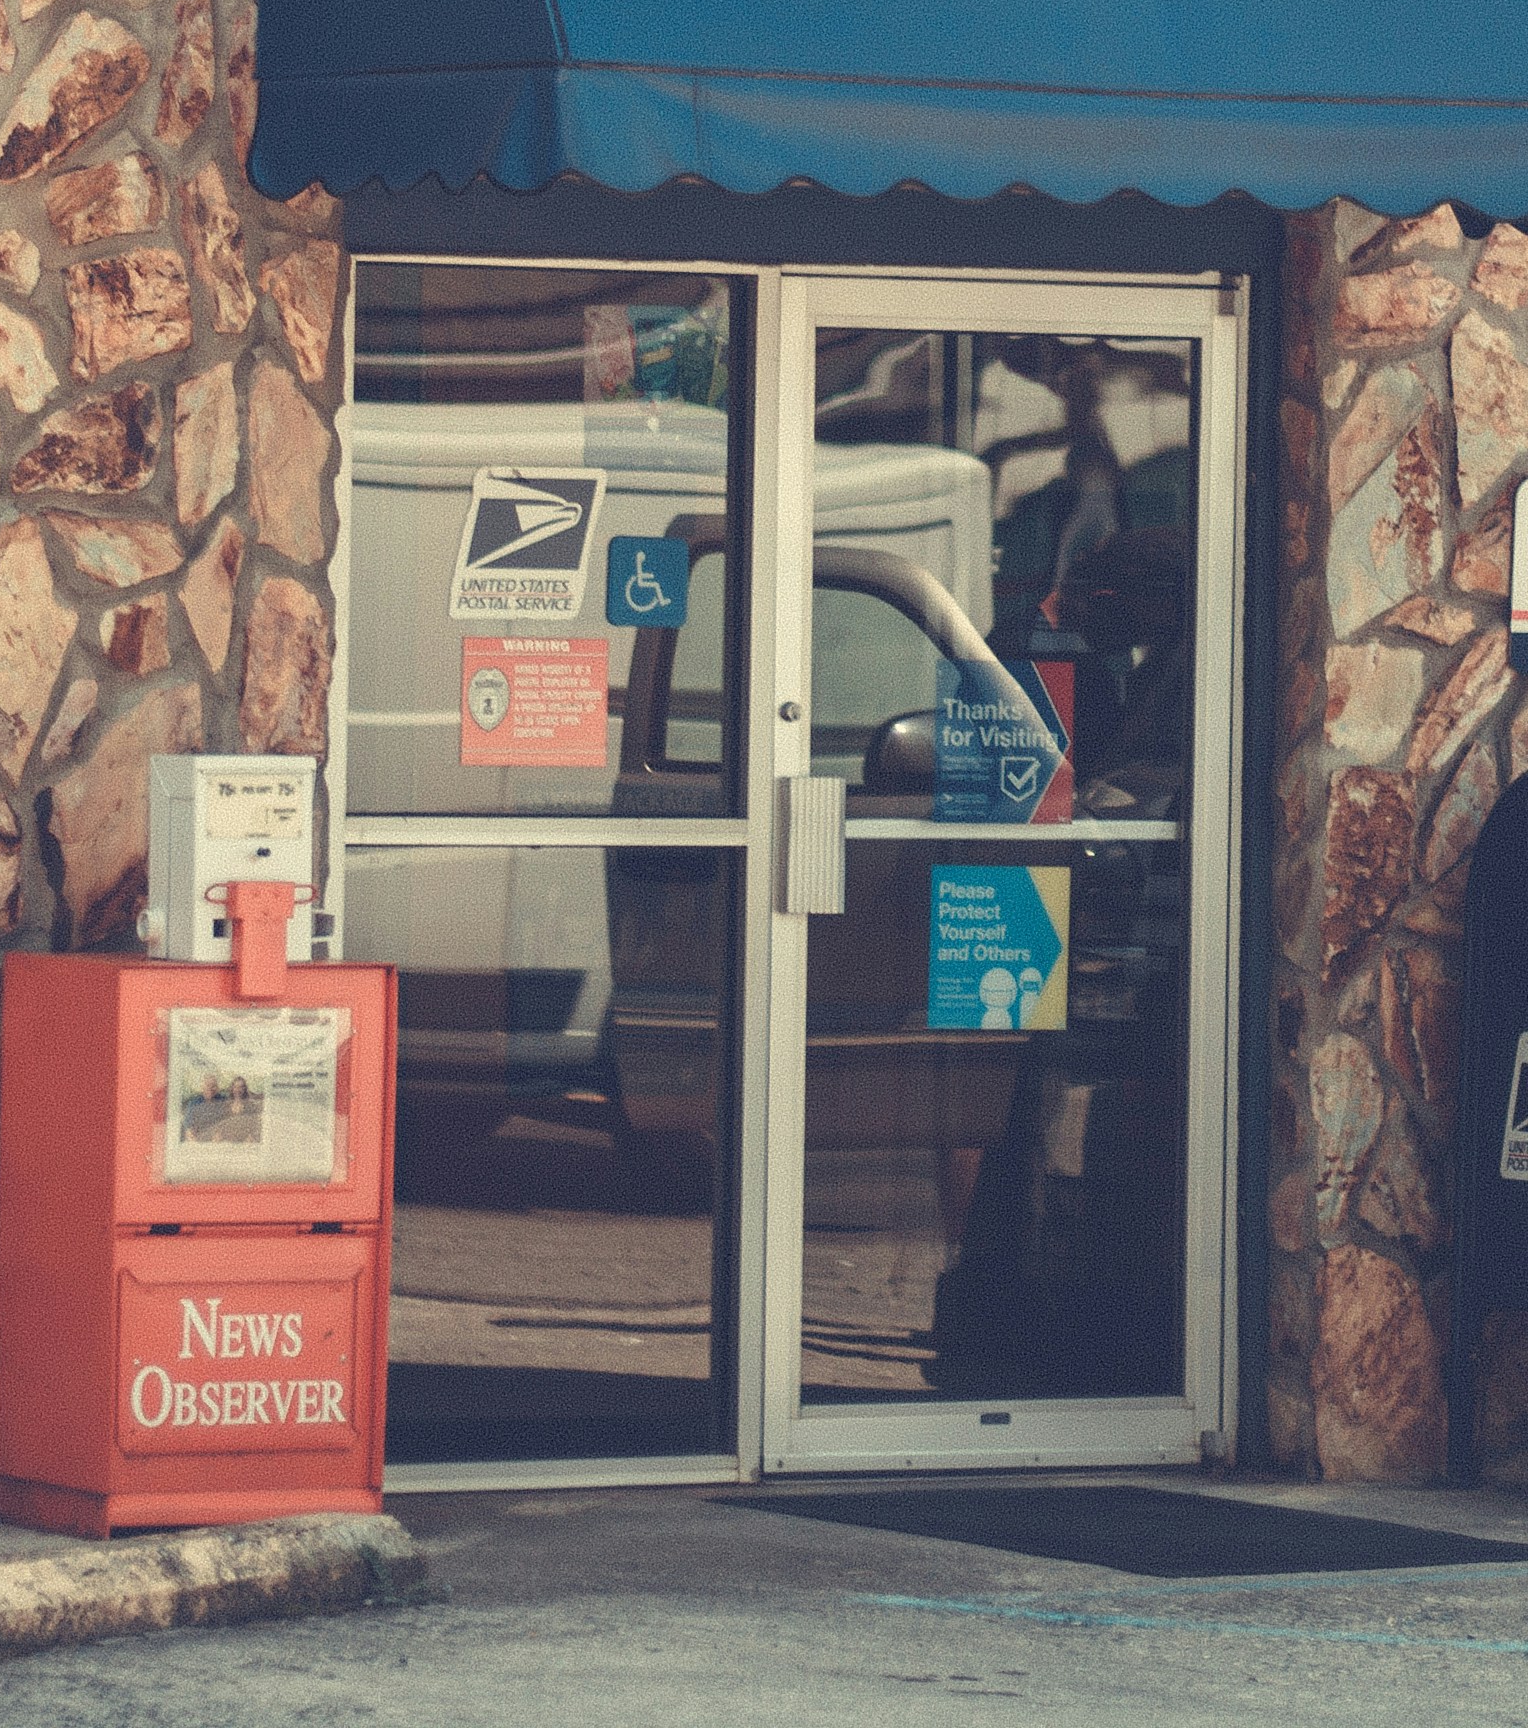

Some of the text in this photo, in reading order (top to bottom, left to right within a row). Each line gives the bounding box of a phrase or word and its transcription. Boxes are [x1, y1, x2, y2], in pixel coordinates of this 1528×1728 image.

[461, 578, 571, 593] UNITED STATES
[456, 596, 573, 611] POSTAL SERVICE
[502, 639, 570, 653] WARNING
[943, 697, 1023, 721] Thanks
[941, 725, 1059, 754] for Visiting
[939, 881, 996, 899] Please
[939, 902, 1002, 920] Protect
[938, 923, 1007, 941] Yourself
[937, 944, 1032, 962] and Others
[178, 1297, 304, 1360] NEWS
[130, 1364, 348, 1429] OBSERVER
